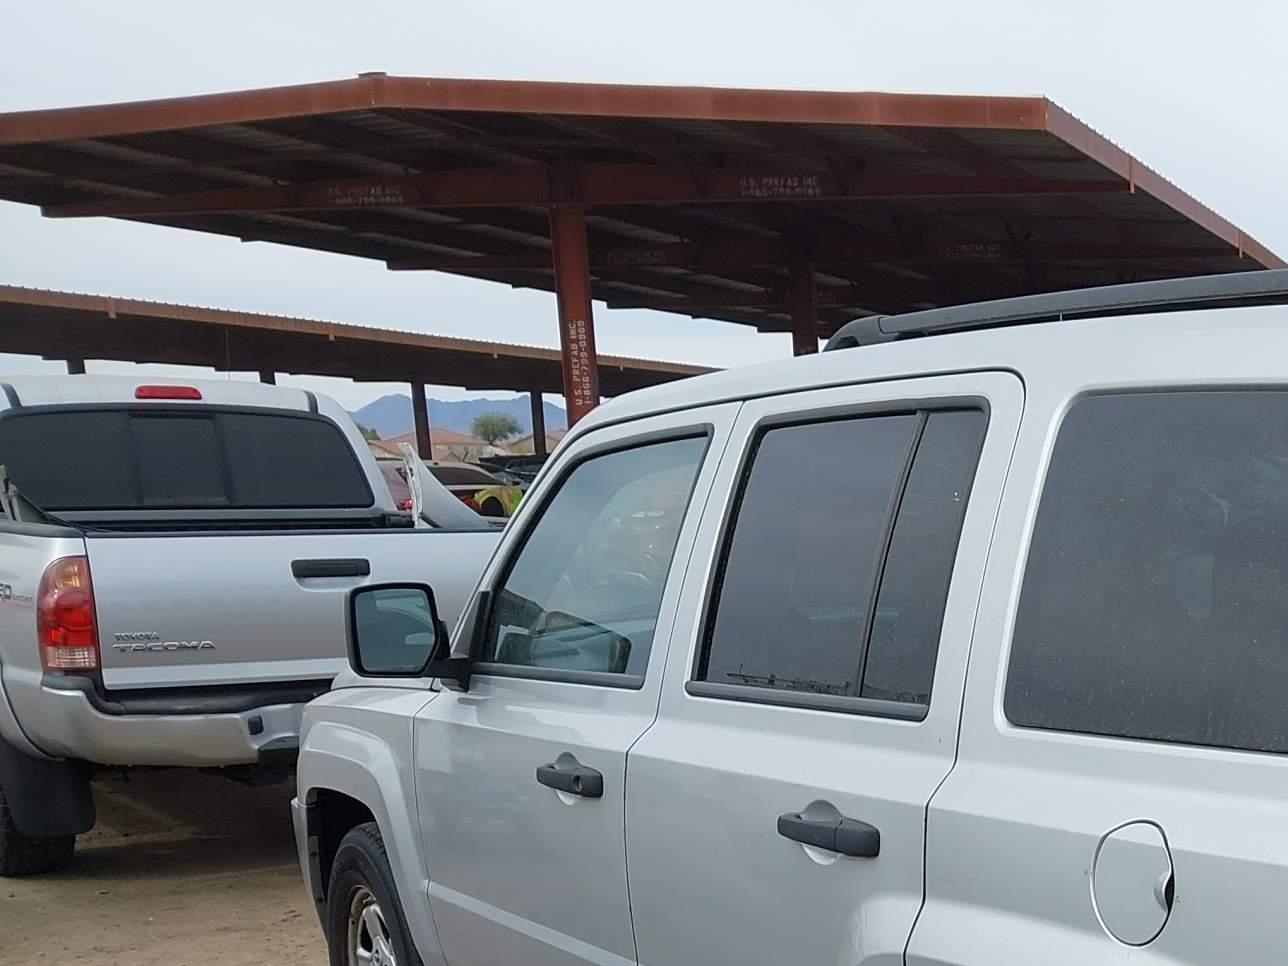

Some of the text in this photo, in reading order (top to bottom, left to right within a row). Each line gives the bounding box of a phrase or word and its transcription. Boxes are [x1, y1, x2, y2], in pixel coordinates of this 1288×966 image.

[570, 342, 581, 382] PREFAB
[113, 631, 160, 641] TOYOTA
[112, 640, 217, 653] TACOMA
